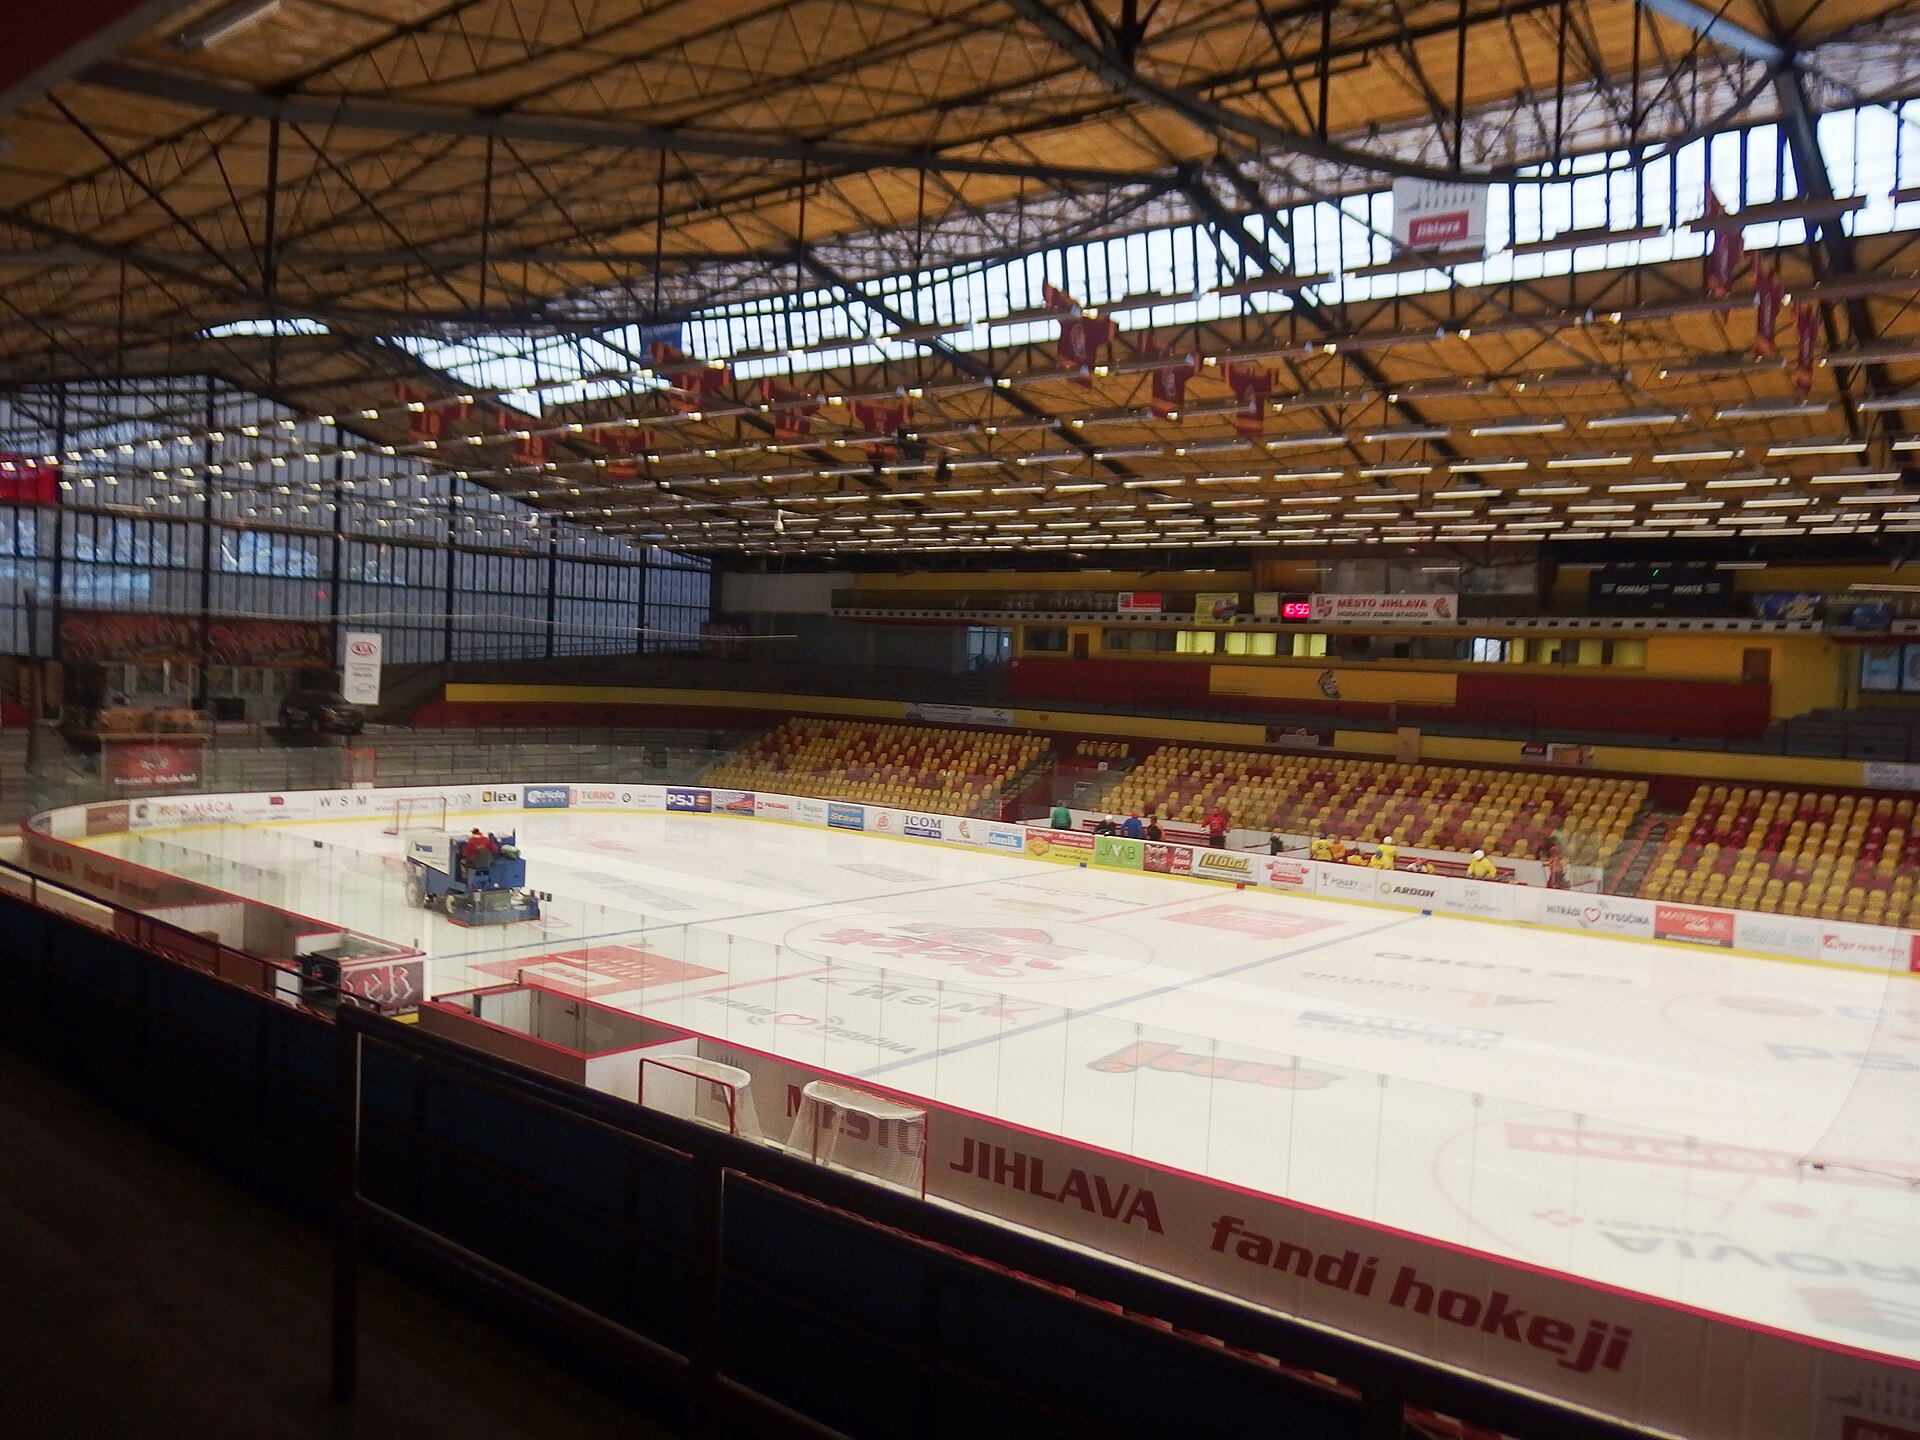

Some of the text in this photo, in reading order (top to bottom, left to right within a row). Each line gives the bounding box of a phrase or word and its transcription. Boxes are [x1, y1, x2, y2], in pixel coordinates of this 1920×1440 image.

[1379, 599, 1428, 608] JIHLAVA
[581, 791, 616, 800] TERNO
[667, 794, 694, 806] PSJ
[904, 815, 942, 829] ICOM
[1393, 886, 1435, 898] ARDON
[950, 1137, 1165, 1234] JIHLAVA
[1210, 1214, 1380, 1297] fandí
[1389, 1267, 1632, 1374] hokeji
